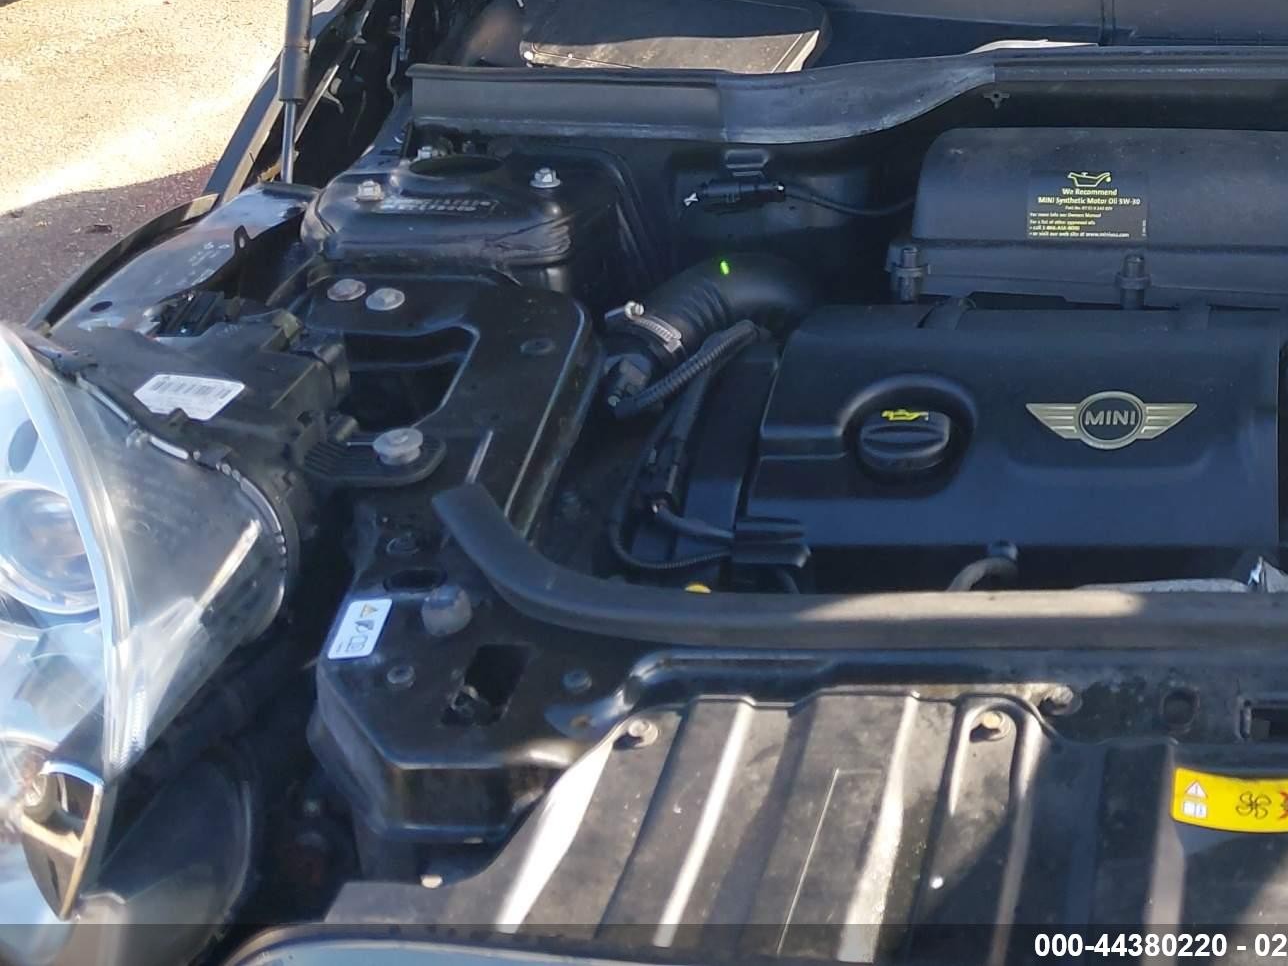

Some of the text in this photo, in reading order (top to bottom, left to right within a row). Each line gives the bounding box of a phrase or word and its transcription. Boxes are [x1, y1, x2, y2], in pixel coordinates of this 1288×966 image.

[1061, 187, 1118, 196] We Recommend
[1037, 196, 1141, 206] MINI Synthetic Motor Oil 5W-30
[1084, 409, 1137, 426] MINI
